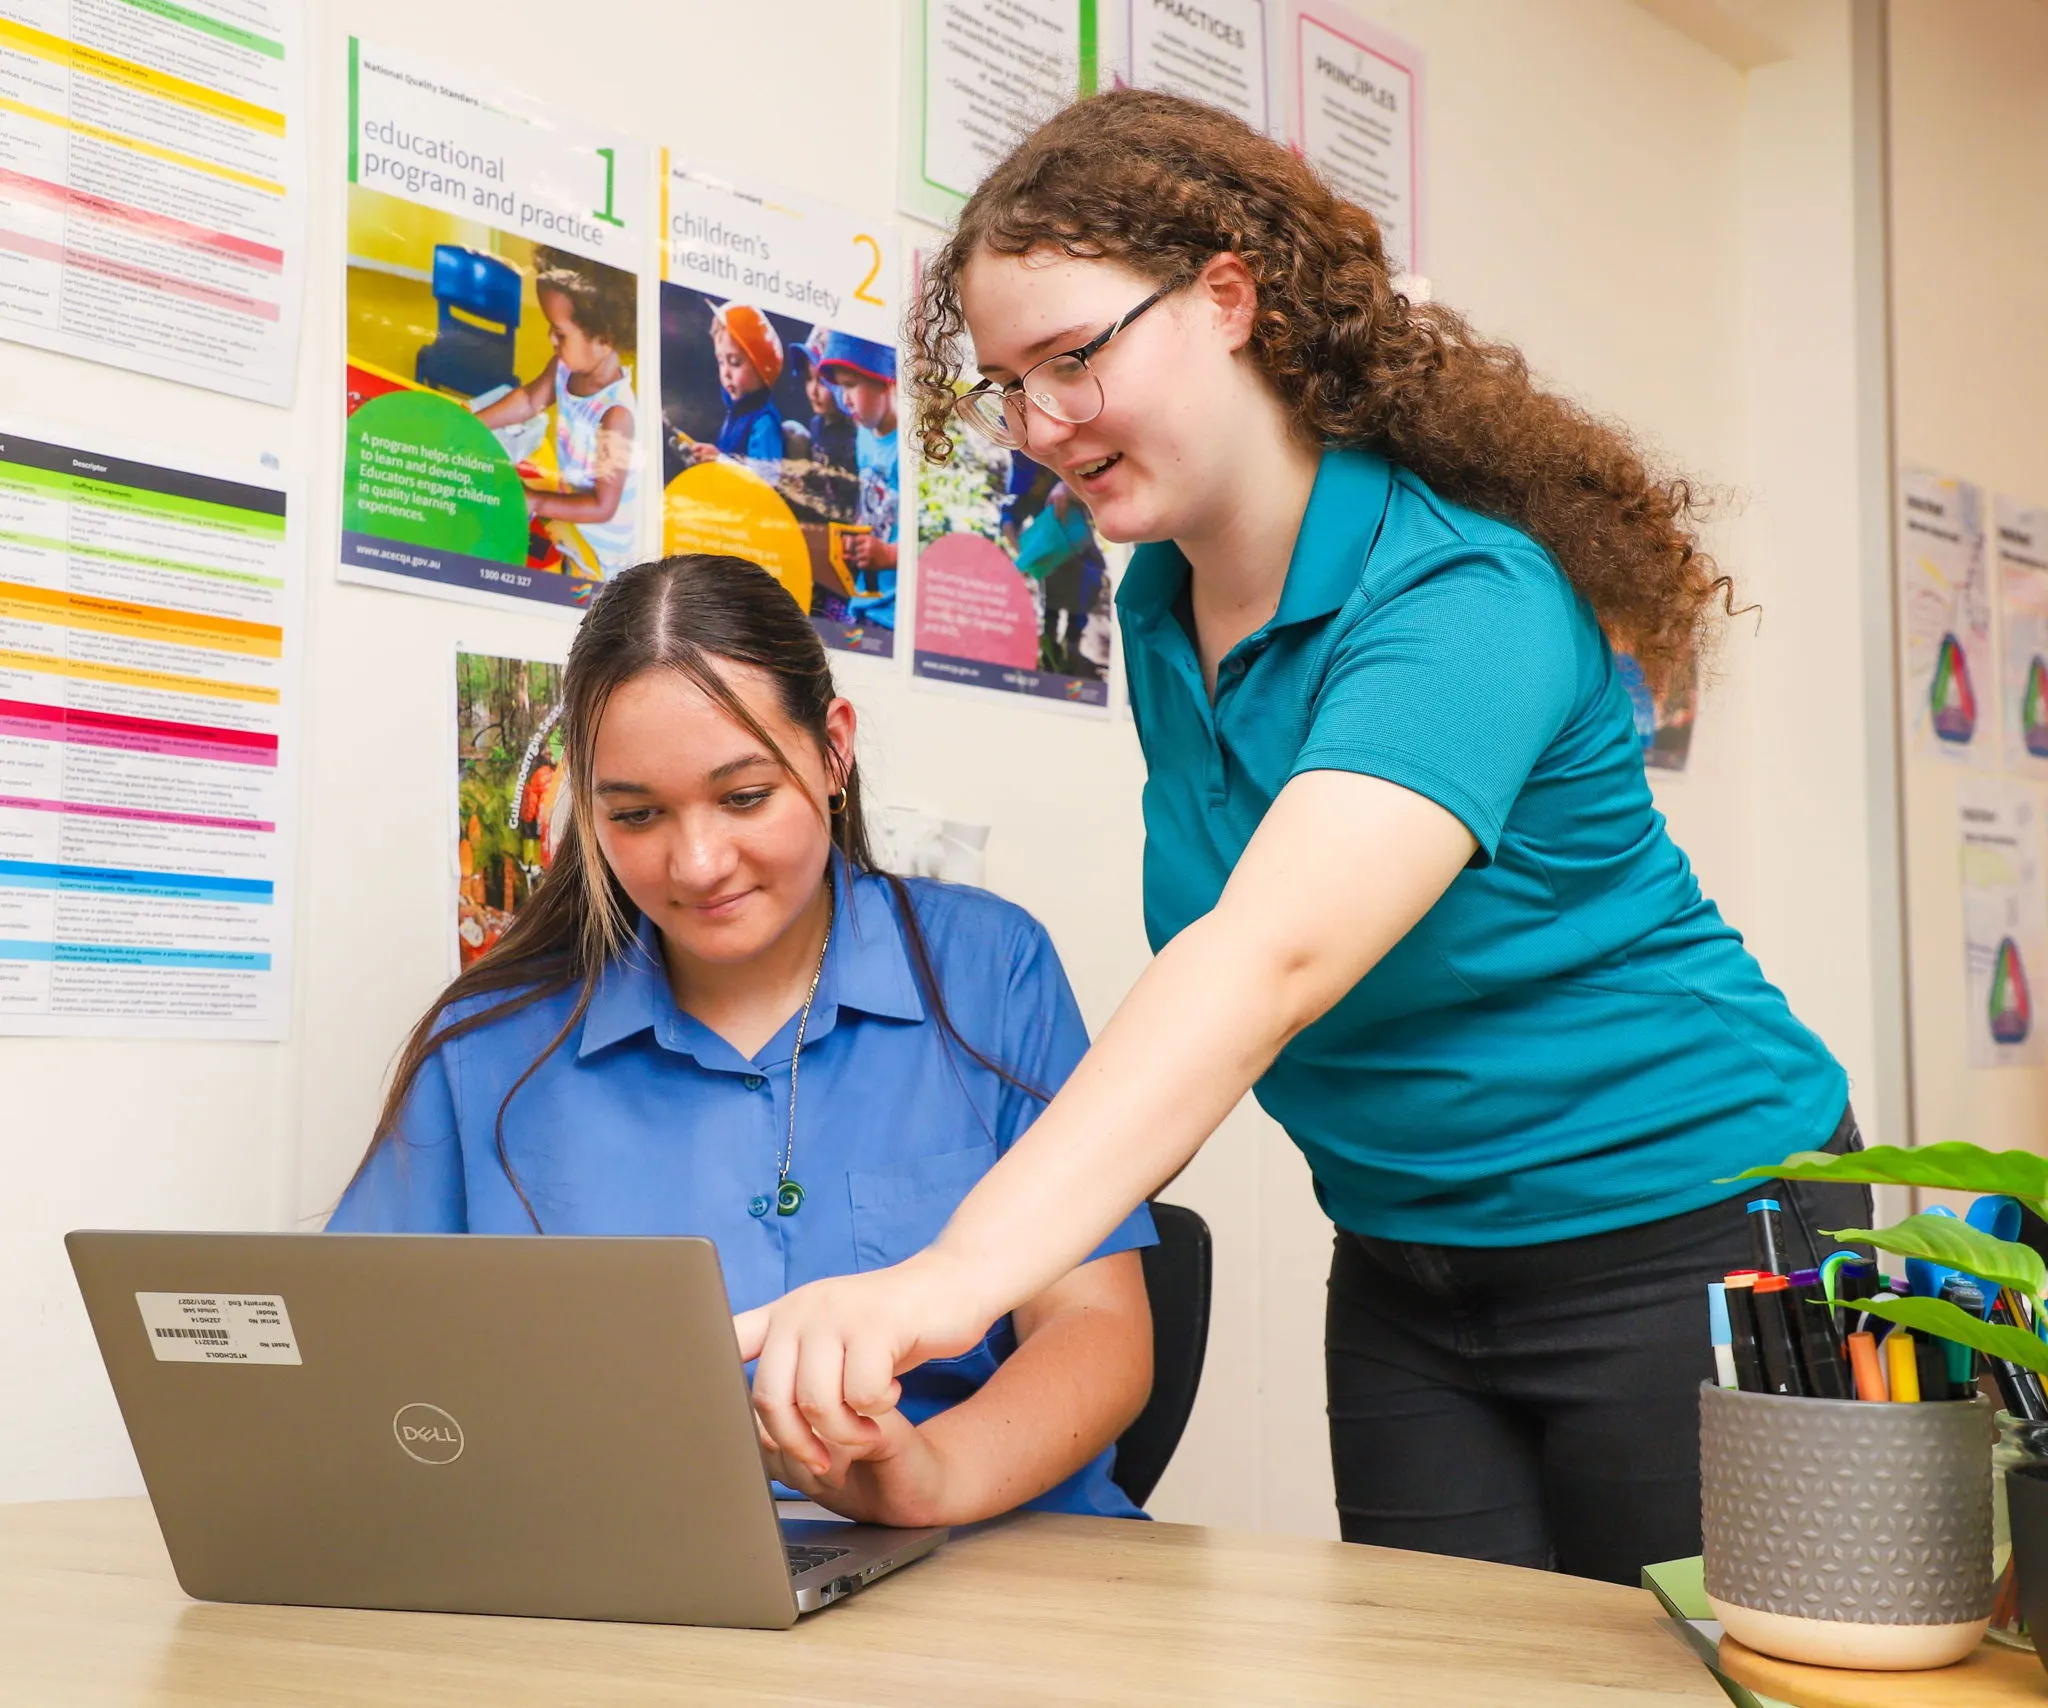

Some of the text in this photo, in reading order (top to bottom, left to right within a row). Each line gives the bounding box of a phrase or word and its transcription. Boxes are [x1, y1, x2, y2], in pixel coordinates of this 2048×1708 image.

[364, 60, 403, 81] National
[405, 74, 438, 94] Quality
[1315, 55, 1397, 112] PRINCIPLES
[365, 119, 505, 182] educational
[365, 152, 604, 247] program and practice
[592, 148, 625, 228] 1
[672, 212, 771, 261] children's
[672, 239, 842, 318] health and safety
[852, 233, 886, 306] 2
[72, 458, 108, 473] Descriptor
[360, 449, 474, 485] to learn and develop.
[361, 432, 495, 473] A program helps children
[358, 480, 457, 515] in quality learning
[359, 464, 500, 506] Educators engage children
[357, 498, 427, 522] experiences.
[243, 1299, 276, 1307] Warranty
[205, 1351, 248, 1359] NTSCHOOLS
[402, 1425, 457, 1443] DELL
